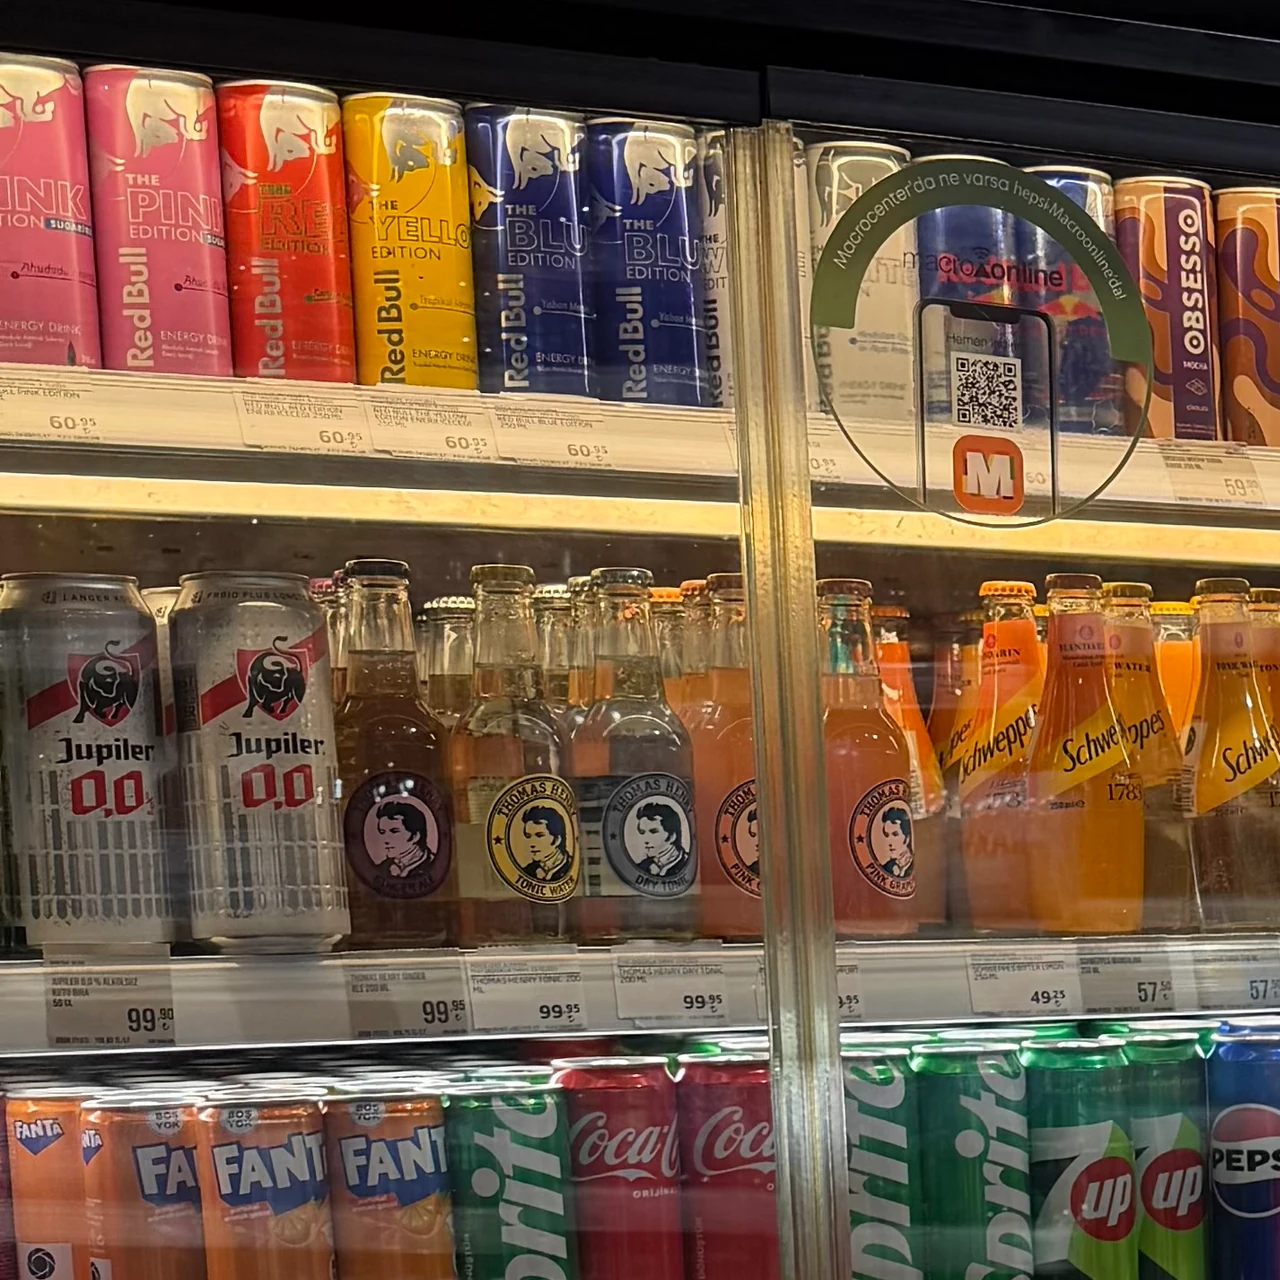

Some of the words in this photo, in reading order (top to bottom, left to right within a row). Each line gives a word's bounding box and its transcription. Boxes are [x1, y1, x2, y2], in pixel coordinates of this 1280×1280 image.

[0, 176, 87, 220] INK
[126, 173, 160, 186] THE
[939, 173, 960, 187] ne
[963, 174, 1010, 191] varsa
[505, 205, 537, 216] THE
[624, 220, 654, 230] THE
[129, 226, 203, 243] EDITION
[370, 216, 470, 249] YELLO
[507, 218, 589, 256] BLU
[624, 232, 701, 270] BLU
[372, 247, 440, 261] EDITION
[508, 253, 575, 269] EDITION
[119, 247, 150, 304] Bull
[251, 258, 281, 313] Bull
[626, 266, 690, 282] EDITION
[1178, 208, 1205, 355] OBSESSO
[373, 269, 403, 323] Bull
[497, 274, 527, 328] Bull
[616, 287, 643, 339] Bull
[123, 309, 154, 367] Red
[161, 330, 205, 343] ENERGY
[255, 320, 285, 377] Red
[412, 349, 453, 361] ENERGY
[378, 328, 406, 384] Red
[501, 335, 529, 389] Red
[619, 348, 648, 399] Red
[55, 737, 155, 765] Jupiler
[228, 731, 326, 759] Jupiler
[958, 704, 1039, 784] Schweppe
[499, 778, 548, 818] THOMAS
[612, 776, 662, 814] THOMAS
[859, 779, 901, 816] THOMAS
[515, 875, 547, 897] TONIC
[549, 875, 576, 896] WATER
[14, 1118, 64, 1140] FANTA
[212, 1132, 325, 1196] FANT
[340, 1126, 447, 1188] FANT
